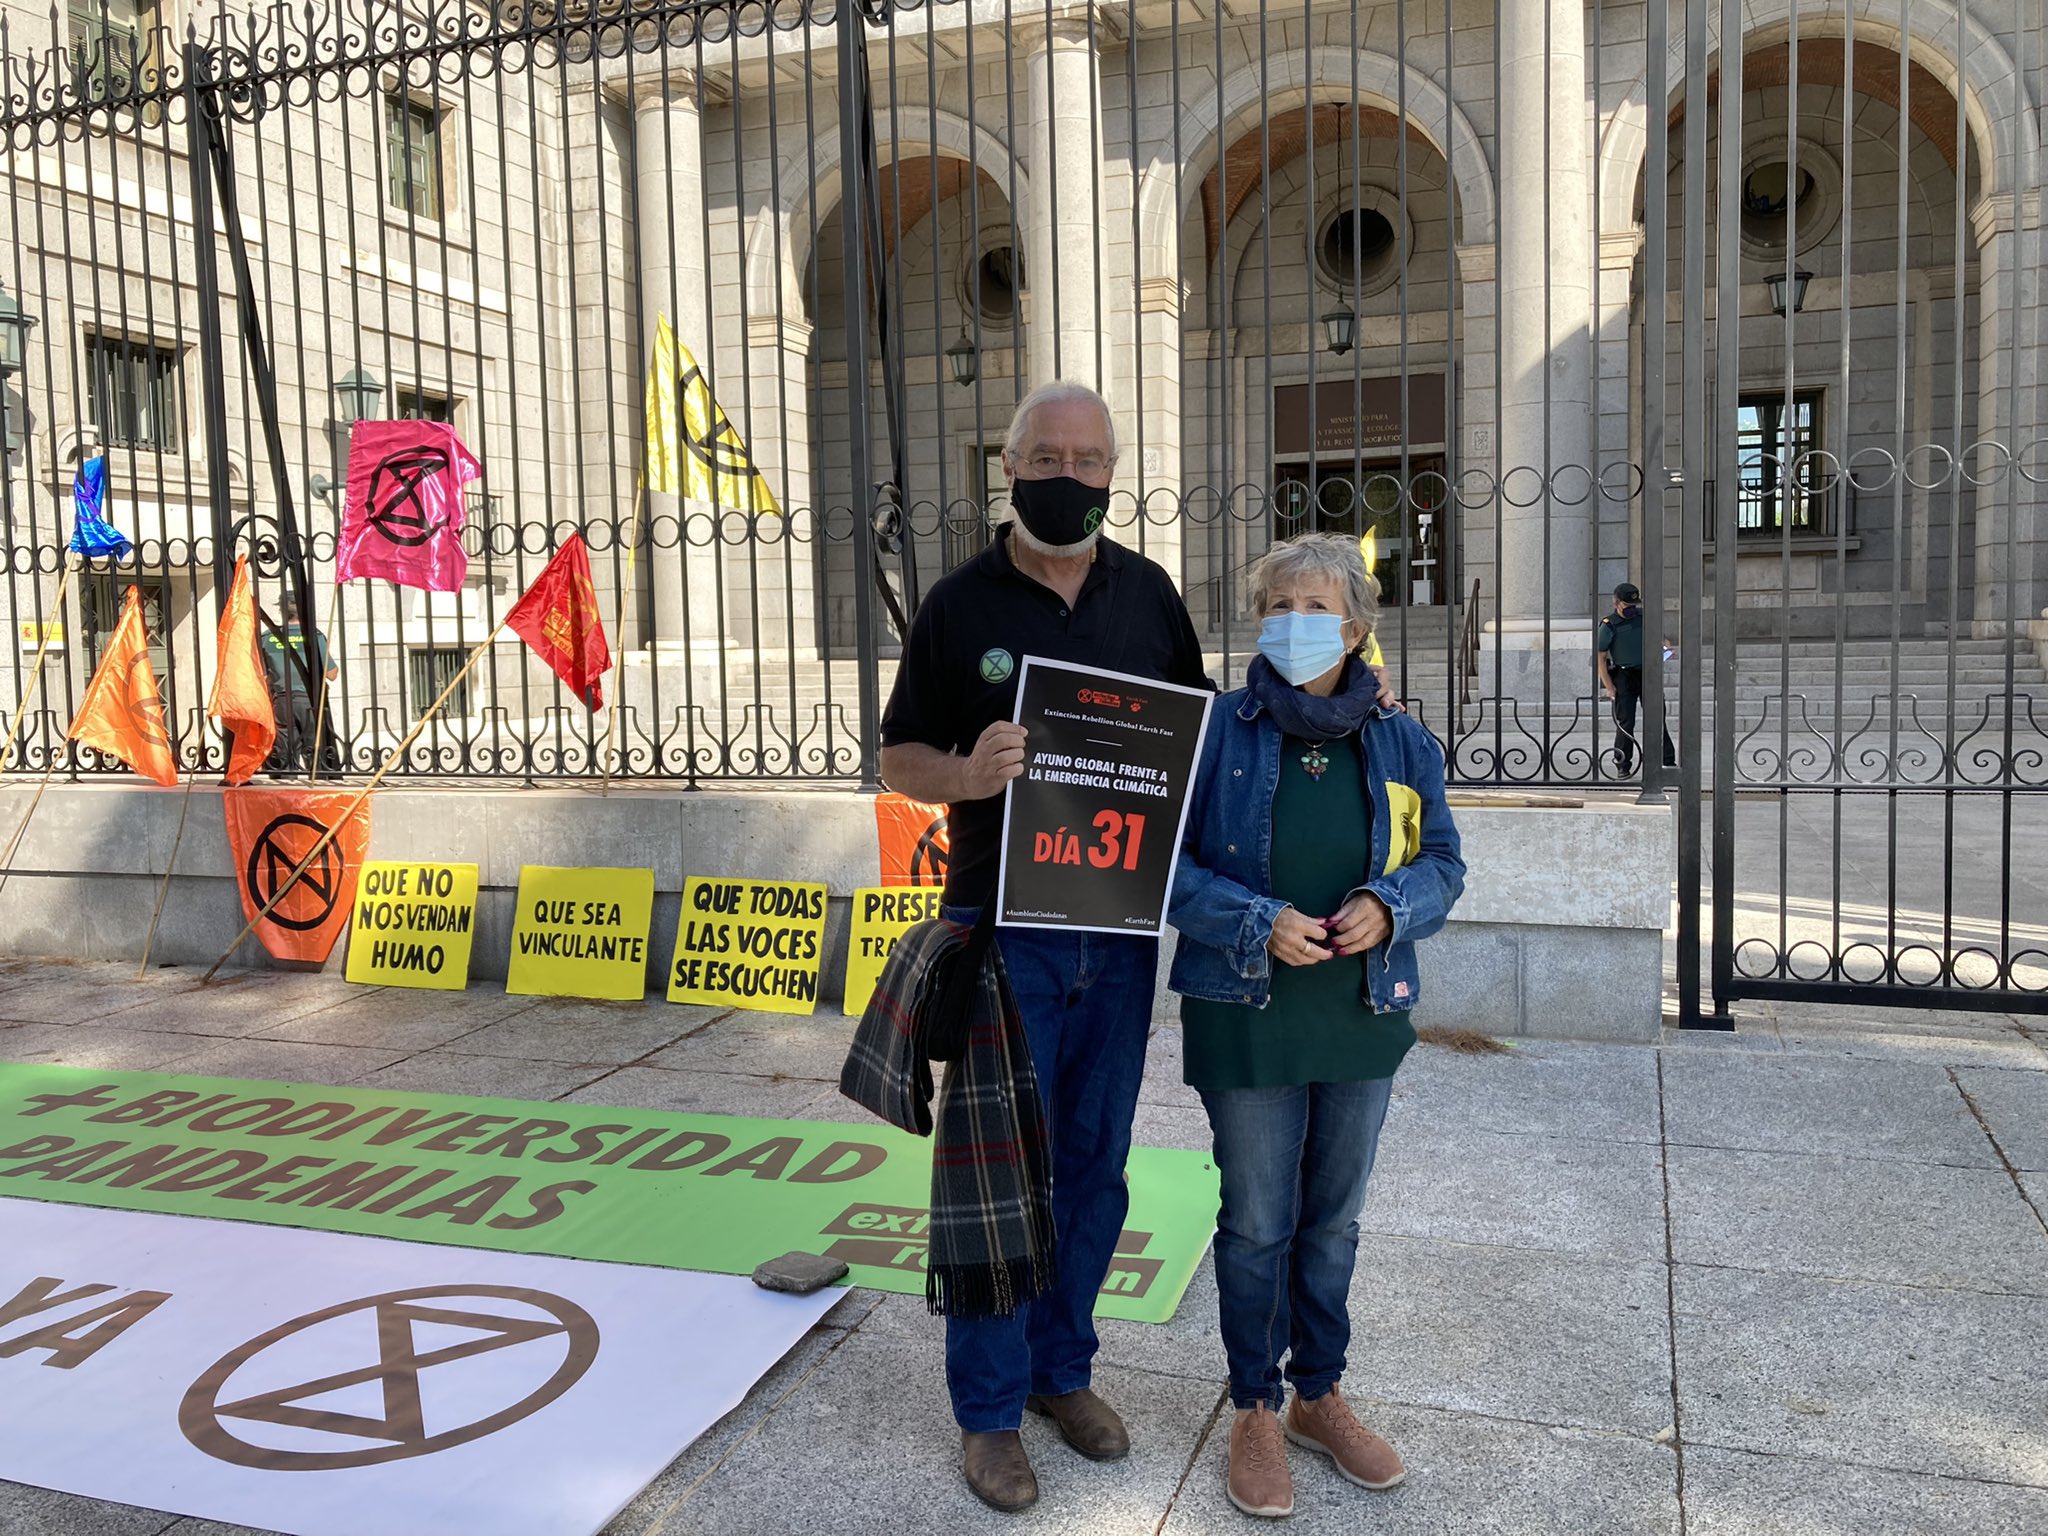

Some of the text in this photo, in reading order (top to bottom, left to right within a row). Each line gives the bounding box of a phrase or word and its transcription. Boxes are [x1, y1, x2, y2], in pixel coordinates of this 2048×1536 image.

[1325, 426, 1364, 436] TRANSICI
[1367, 424, 1402, 432] ECOLÓGI
[1330, 413, 1388, 424] MINISTIO PARA
[1334, 438, 1353, 446] RETO
[1363, 434, 1403, 443] MOGRÁFICO
[1044, 709, 1173, 737] Extinction Rebellion Global Earth Fast
[1033, 752, 1168, 782] AYUNO GLOBAL FRENTE A
[1028, 768, 1168, 798] LA EMERGENCIA CLIMÁTICA
[1033, 808, 1146, 871] DÍA 31
[365, 868, 453, 898] QUE NO
[534, 900, 622, 926] QUE SEA
[693, 883, 823, 919] QUE TODAS
[864, 891, 941, 922] PRESE
[1125, 917, 1156, 927] #EarthFast
[519, 932, 643, 963] VINCULANTE
[685, 921, 817, 960] LAS VOCES
[860, 937, 898, 957] TRA
[371, 941, 444, 974] HUMO
[675, 959, 818, 1002] SE ESCUCHEN
[0, 1134, 598, 1230] PANDEMIAS
[0, 1276, 174, 1370] YA
